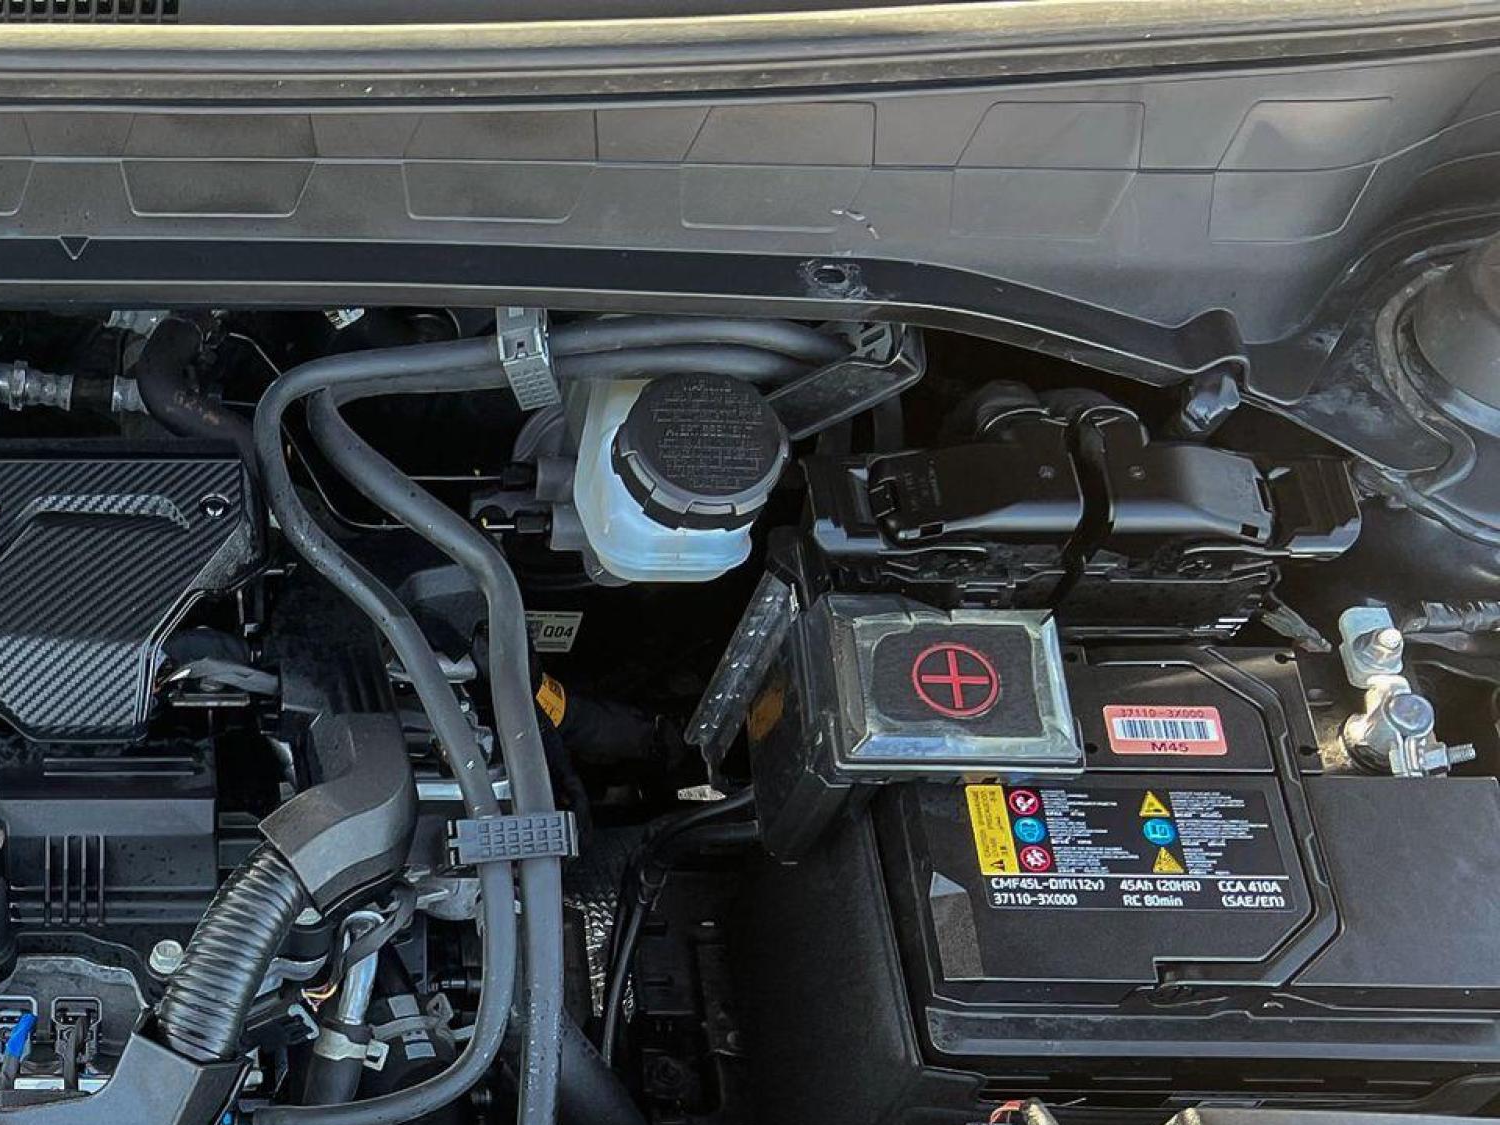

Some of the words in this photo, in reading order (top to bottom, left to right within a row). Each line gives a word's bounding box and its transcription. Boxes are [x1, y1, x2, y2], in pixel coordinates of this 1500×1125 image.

[1120, 880, 1153, 891] 45Ah
[1156, 880, 1201, 891] (20HR)
[1217, 881, 1247, 892] CCA
[1248, 881, 1281, 892] 410A
[994, 893, 1077, 905] 37110-3X000
[1123, 895, 1142, 906] RC
